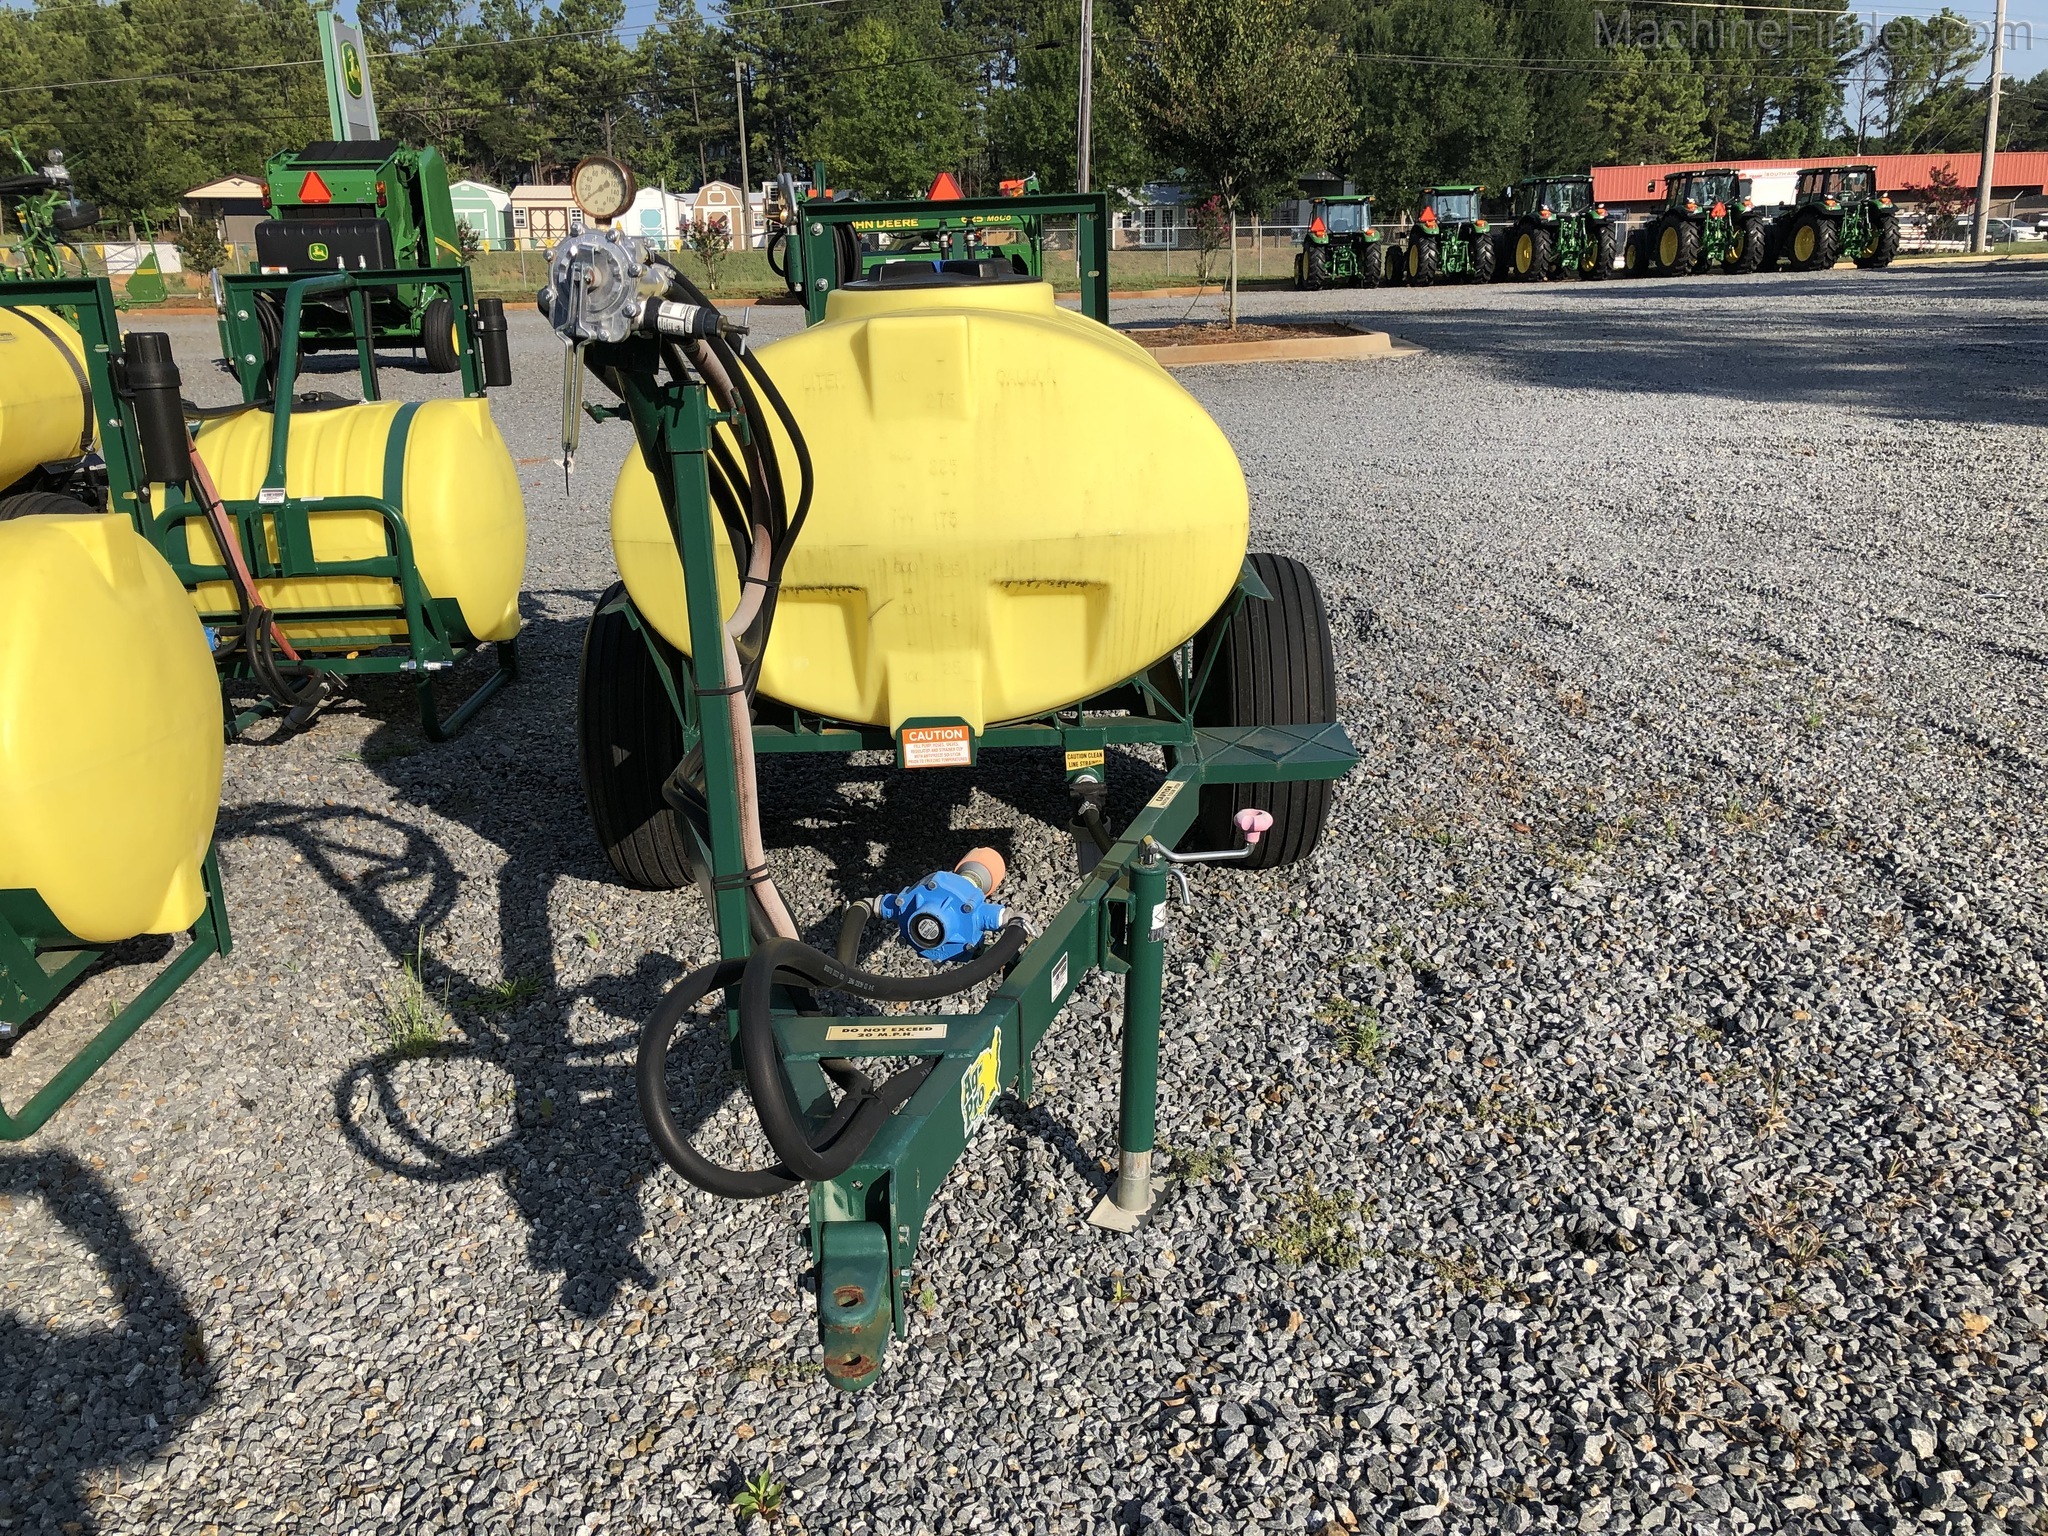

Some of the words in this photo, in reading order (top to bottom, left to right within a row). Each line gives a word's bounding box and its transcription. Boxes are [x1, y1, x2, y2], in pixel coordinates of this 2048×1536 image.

[852, 221, 873, 229] HN
[877, 219, 918, 228] DEERE
[909, 729, 962, 741] CAUTION
